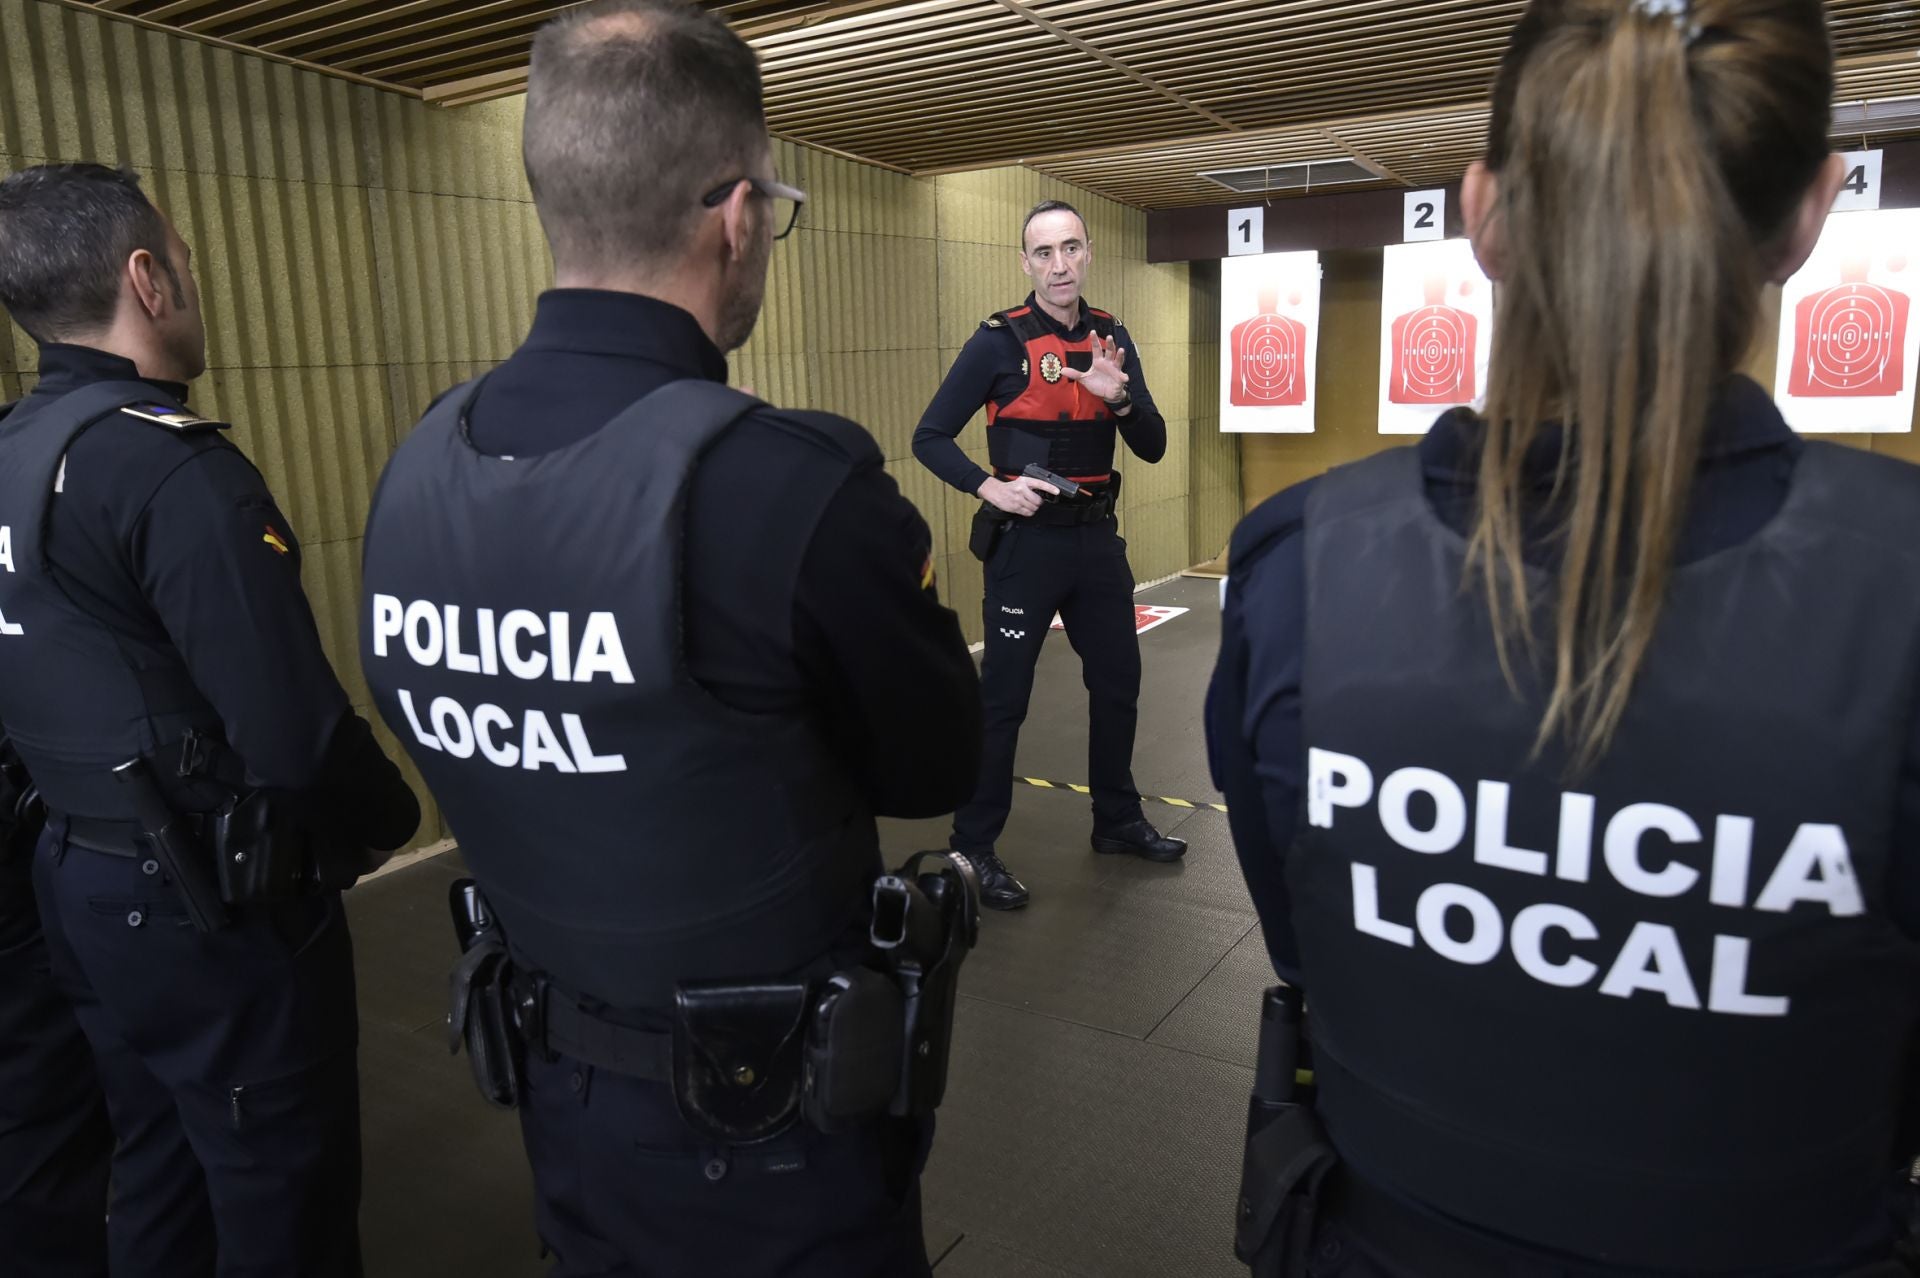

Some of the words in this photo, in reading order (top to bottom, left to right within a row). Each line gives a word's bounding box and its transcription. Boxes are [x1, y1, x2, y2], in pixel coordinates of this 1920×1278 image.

[1841, 165, 1868, 195] 4
[1238, 219, 1250, 243] 1
[1414, 202, 1434, 228] 2
[373, 593, 636, 684] POLICIA
[1001, 605, 1024, 615] POLICIA
[397, 688, 628, 774] LOCAL
[1307, 746, 1866, 917] POLICIA
[1350, 862, 1790, 1016] LOCAL
